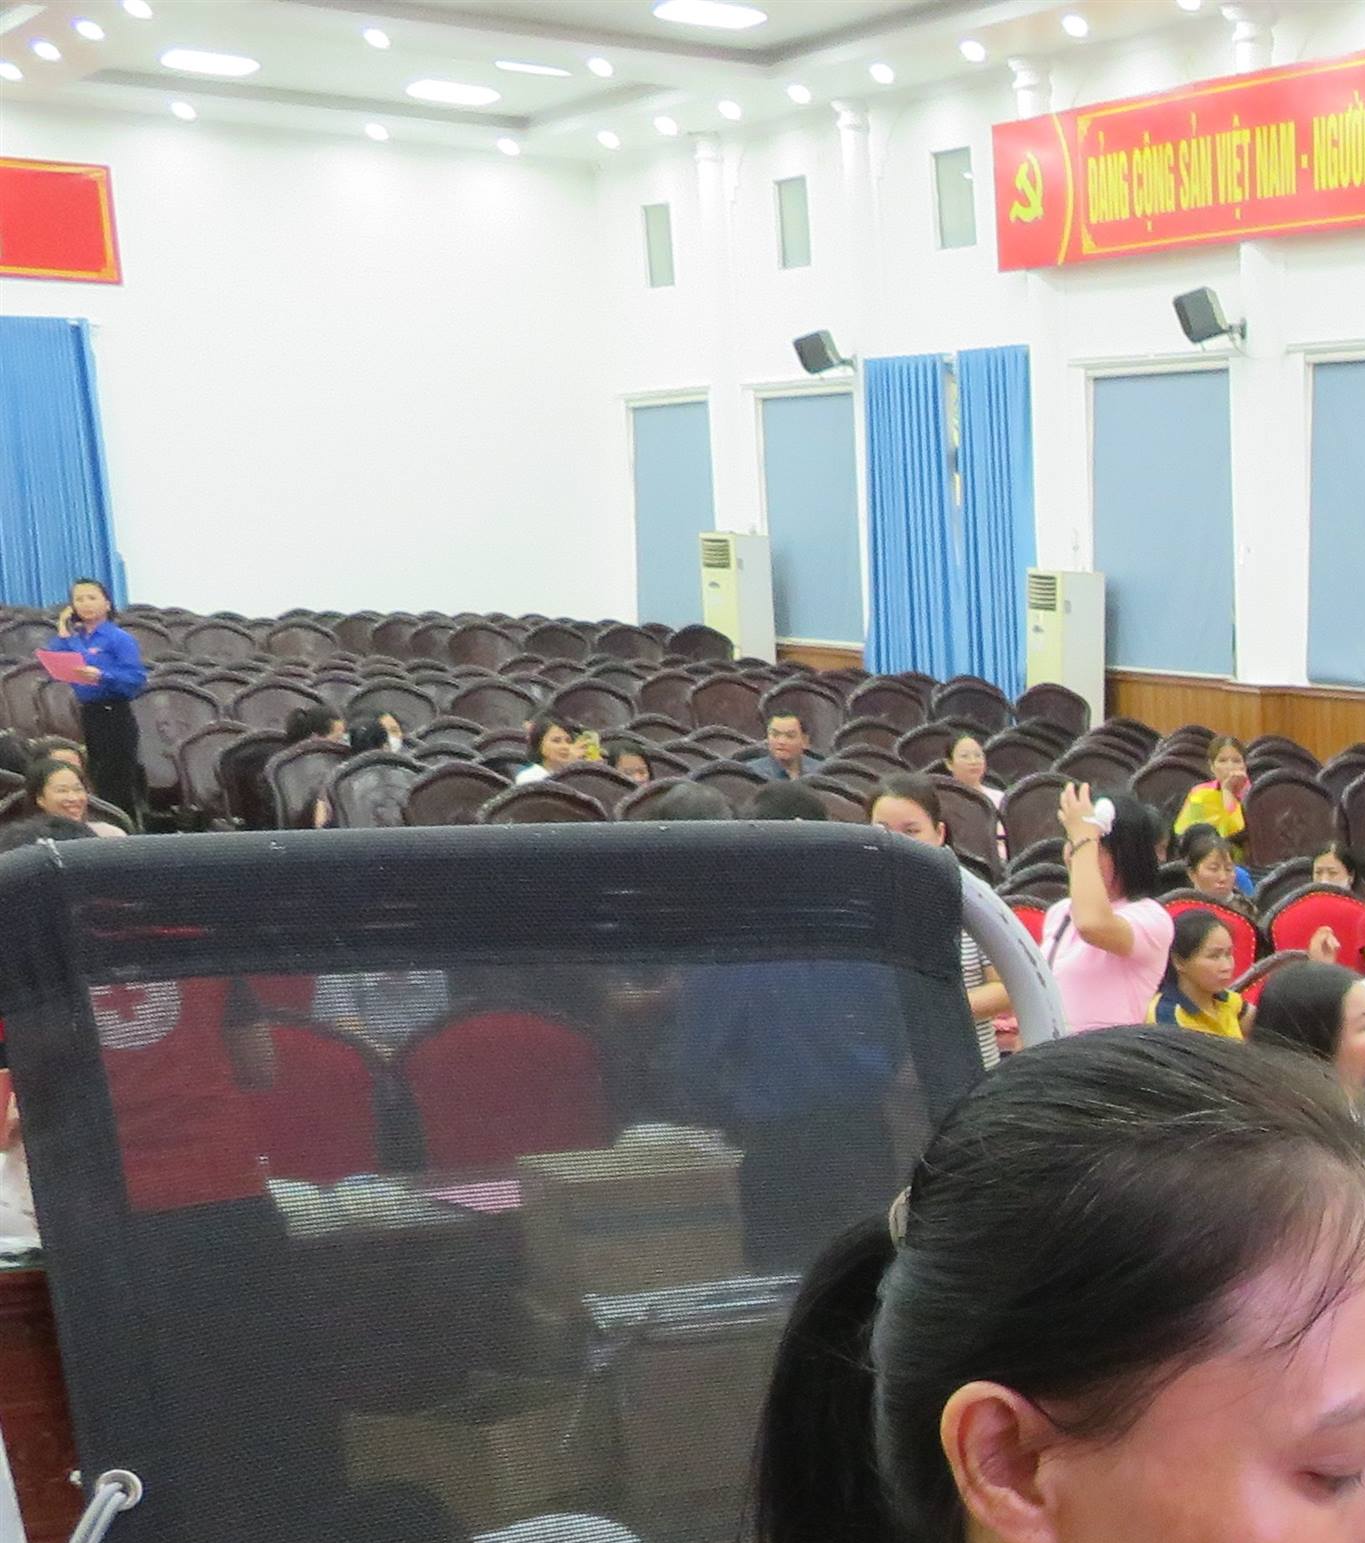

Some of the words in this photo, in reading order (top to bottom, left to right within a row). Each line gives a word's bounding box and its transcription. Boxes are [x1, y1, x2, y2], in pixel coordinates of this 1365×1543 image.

[1132, 131, 1176, 232] CỘNG
[1179, 112, 1213, 211] SẢN
[1215, 113, 1251, 220] VIỆT
[1255, 120, 1297, 200] NAM
